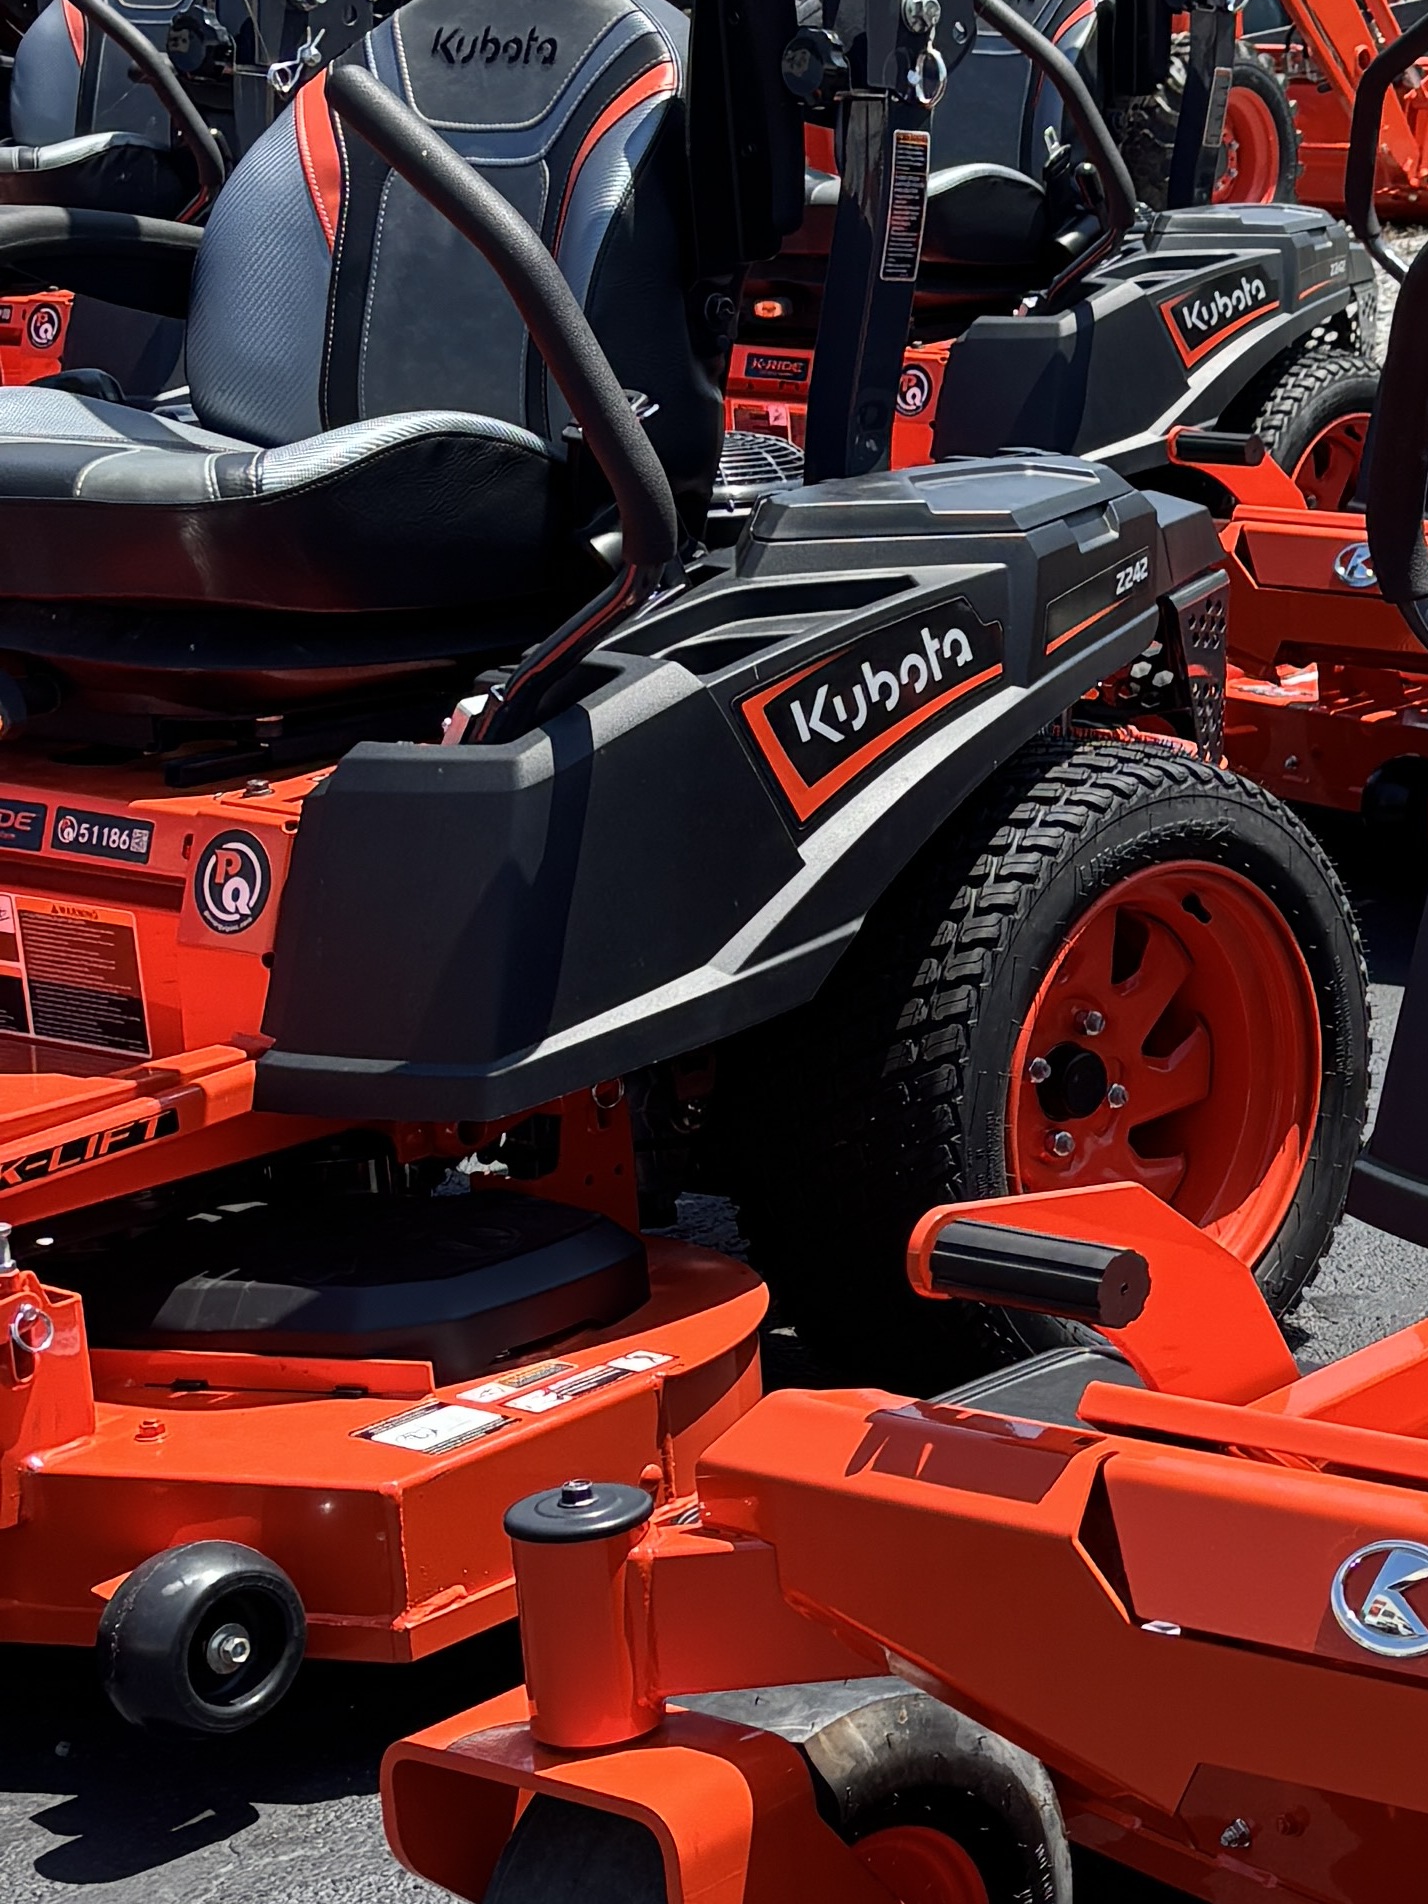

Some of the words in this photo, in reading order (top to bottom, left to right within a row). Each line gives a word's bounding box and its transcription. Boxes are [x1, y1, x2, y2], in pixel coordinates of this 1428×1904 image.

[431, 24, 558, 66] Kubota
[1182, 276, 1267, 332] Kubota
[752, 357, 804, 374] K-RIDE
[1115, 556, 1150, 596] Z242
[789, 626, 974, 743] Kubota
[77, 824, 130, 851] 51186
[0, 1110, 173, 1186] K-LIFT
